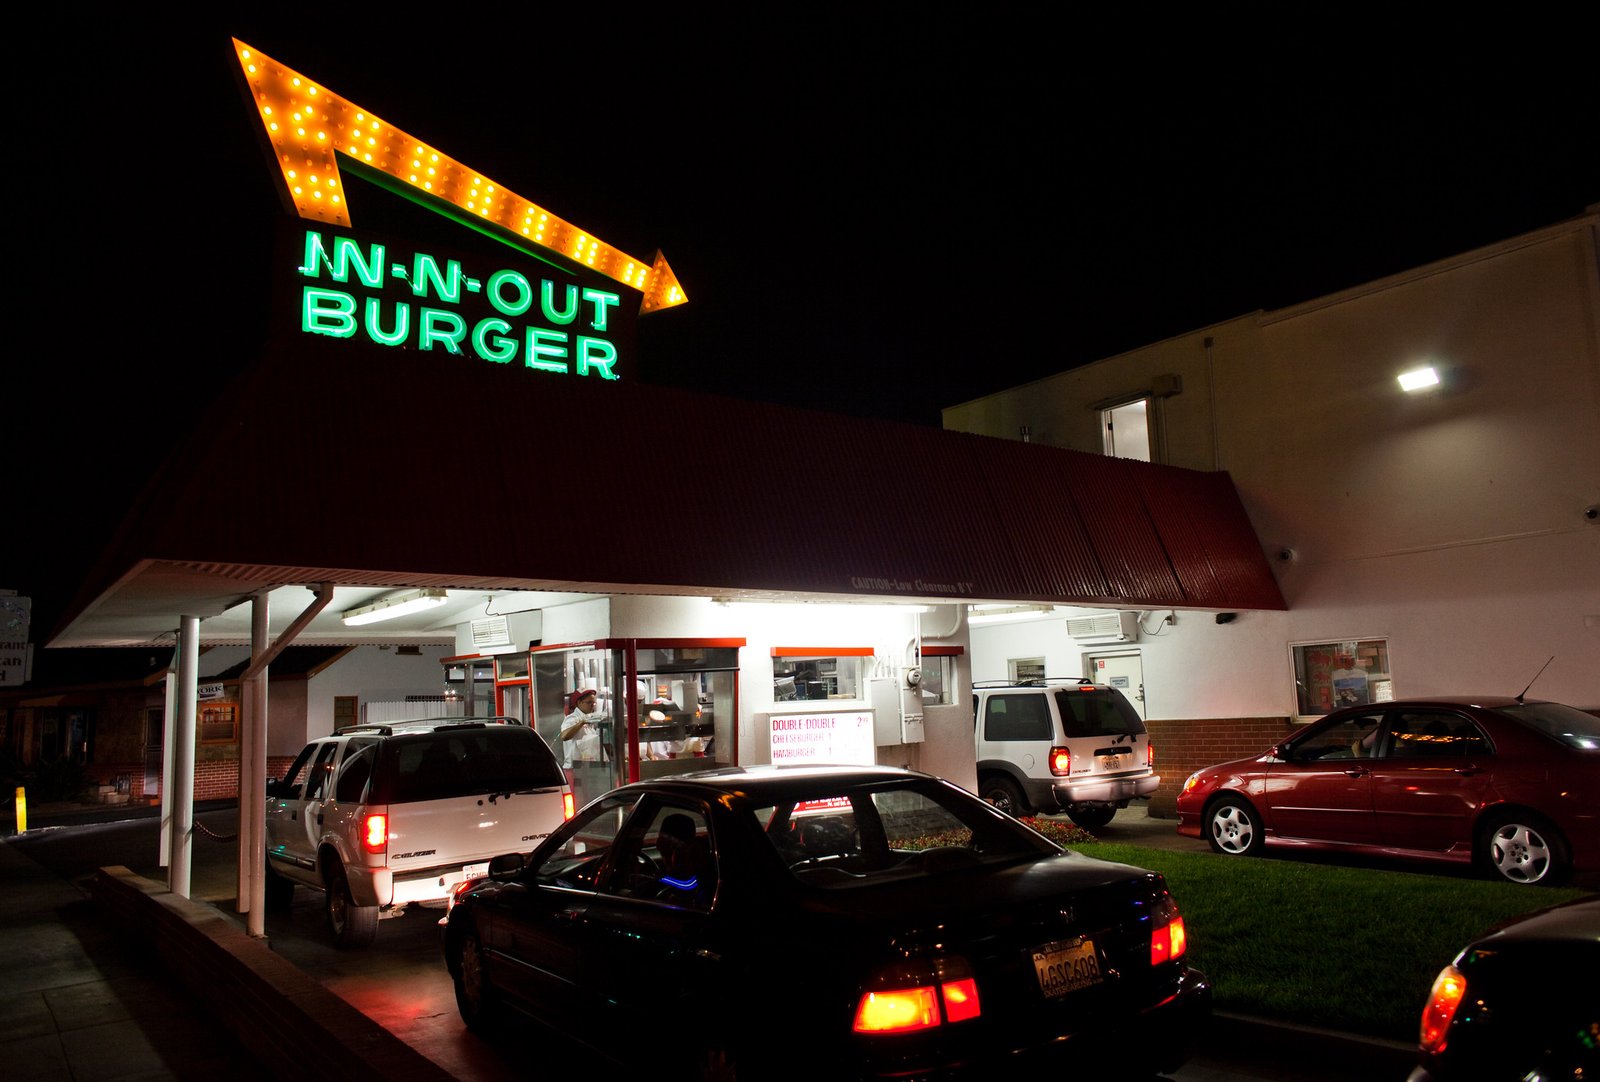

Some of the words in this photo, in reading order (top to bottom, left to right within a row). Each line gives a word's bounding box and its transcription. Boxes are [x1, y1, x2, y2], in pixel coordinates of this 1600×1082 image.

[300, 231, 620, 332] IN-N-OUT
[302, 286, 620, 380] BURGER
[1039, 954, 1098, 989] 4GSC608
